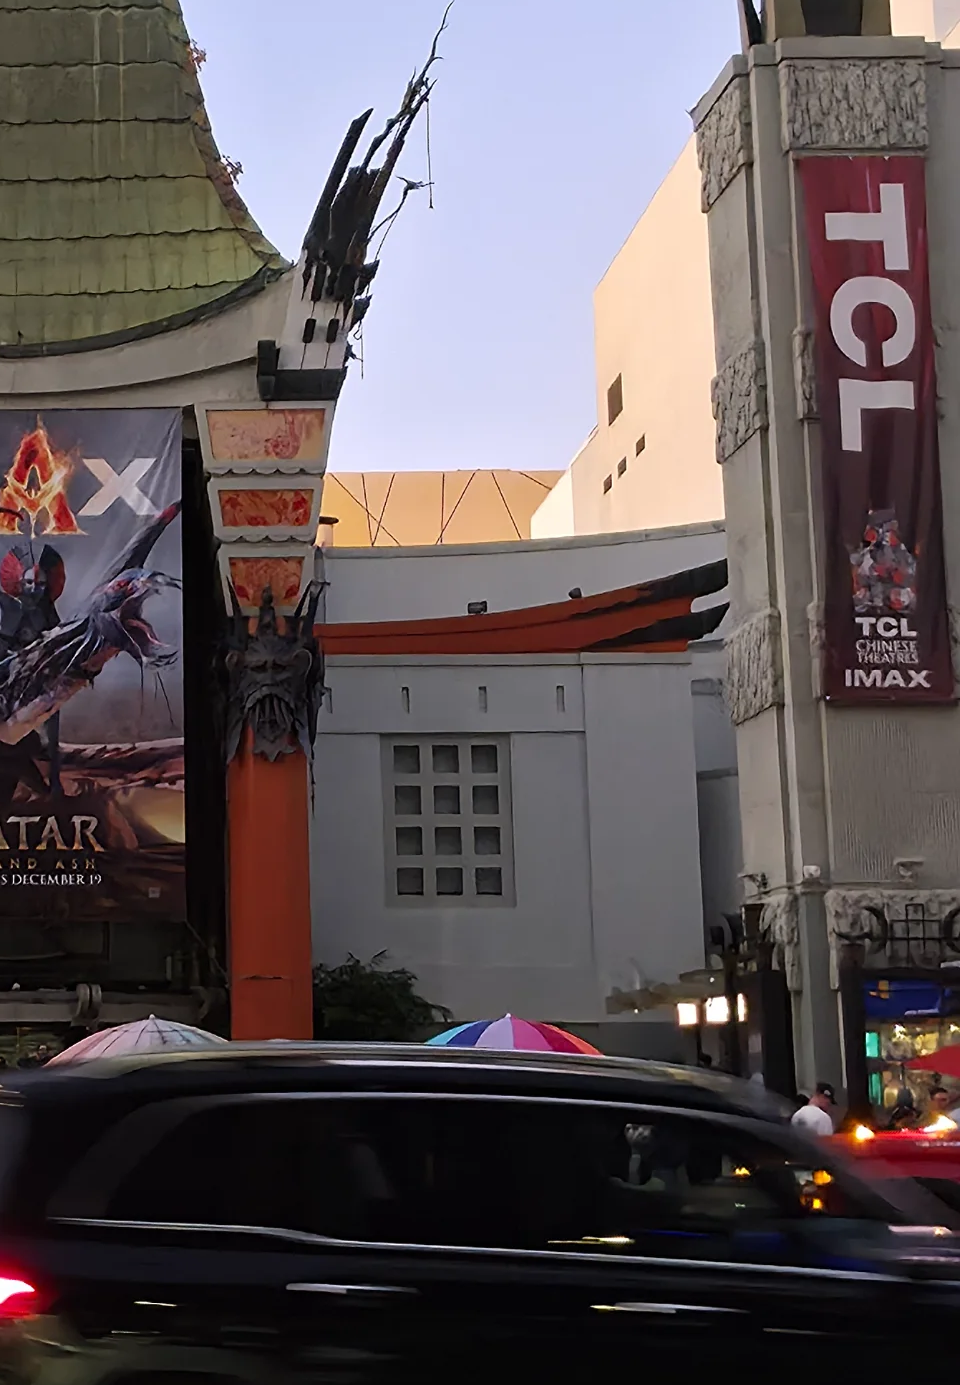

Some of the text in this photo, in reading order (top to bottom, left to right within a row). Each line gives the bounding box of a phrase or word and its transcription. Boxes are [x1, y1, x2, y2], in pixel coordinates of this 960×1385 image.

[824, 183, 915, 452] TCL
[855, 617, 917, 637] TCL
[855, 640, 917, 652] CHINESE
[857, 651, 918, 664] THEATRES
[845, 669, 931, 687] IMAX
[55, 857, 96, 869] ASH
[12, 874, 85, 886] DECEMBER
[90, 874, 102, 885] 19
